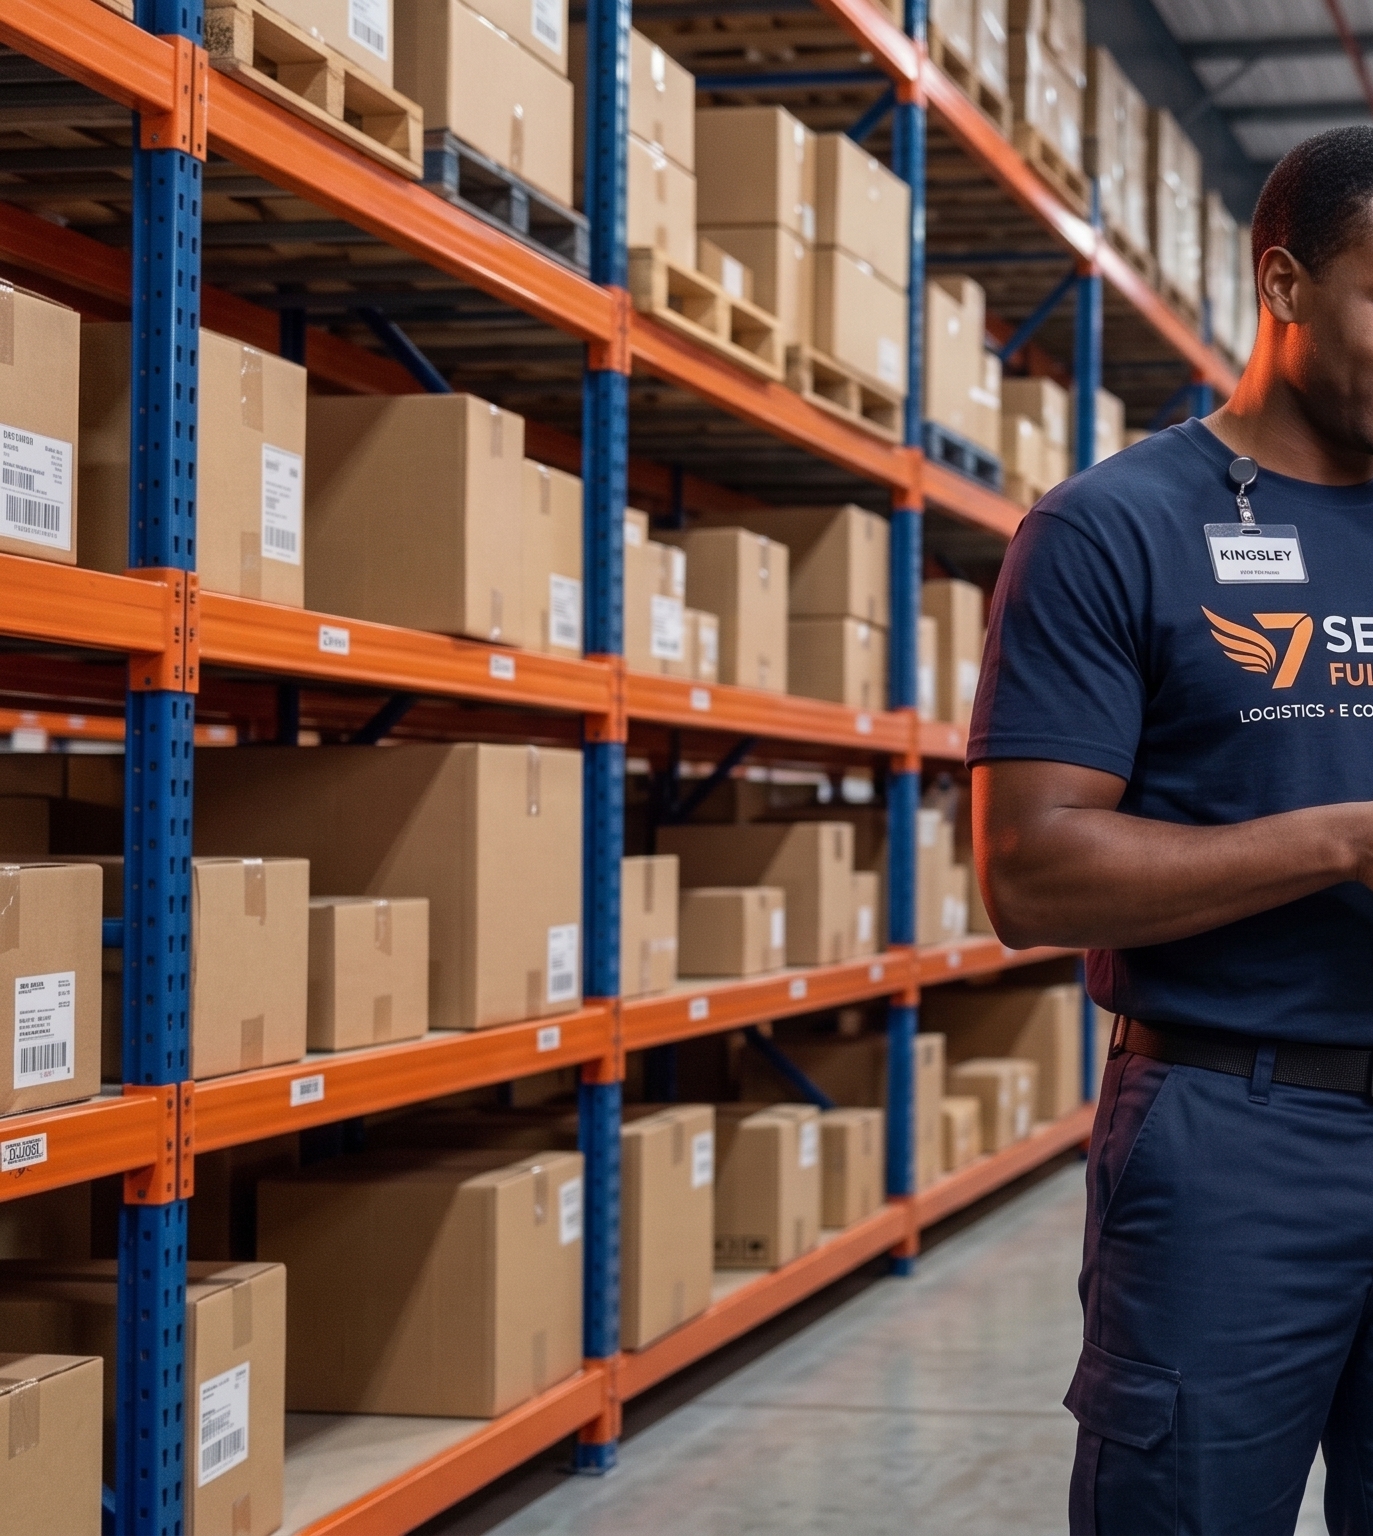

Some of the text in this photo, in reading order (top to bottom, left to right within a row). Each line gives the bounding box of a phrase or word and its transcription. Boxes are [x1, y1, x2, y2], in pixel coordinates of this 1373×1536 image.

[1220, 549, 1292, 562] KINGSLEY
[1239, 703, 1326, 723] LOGISTICS
[1339, 703, 1349, 718] E
